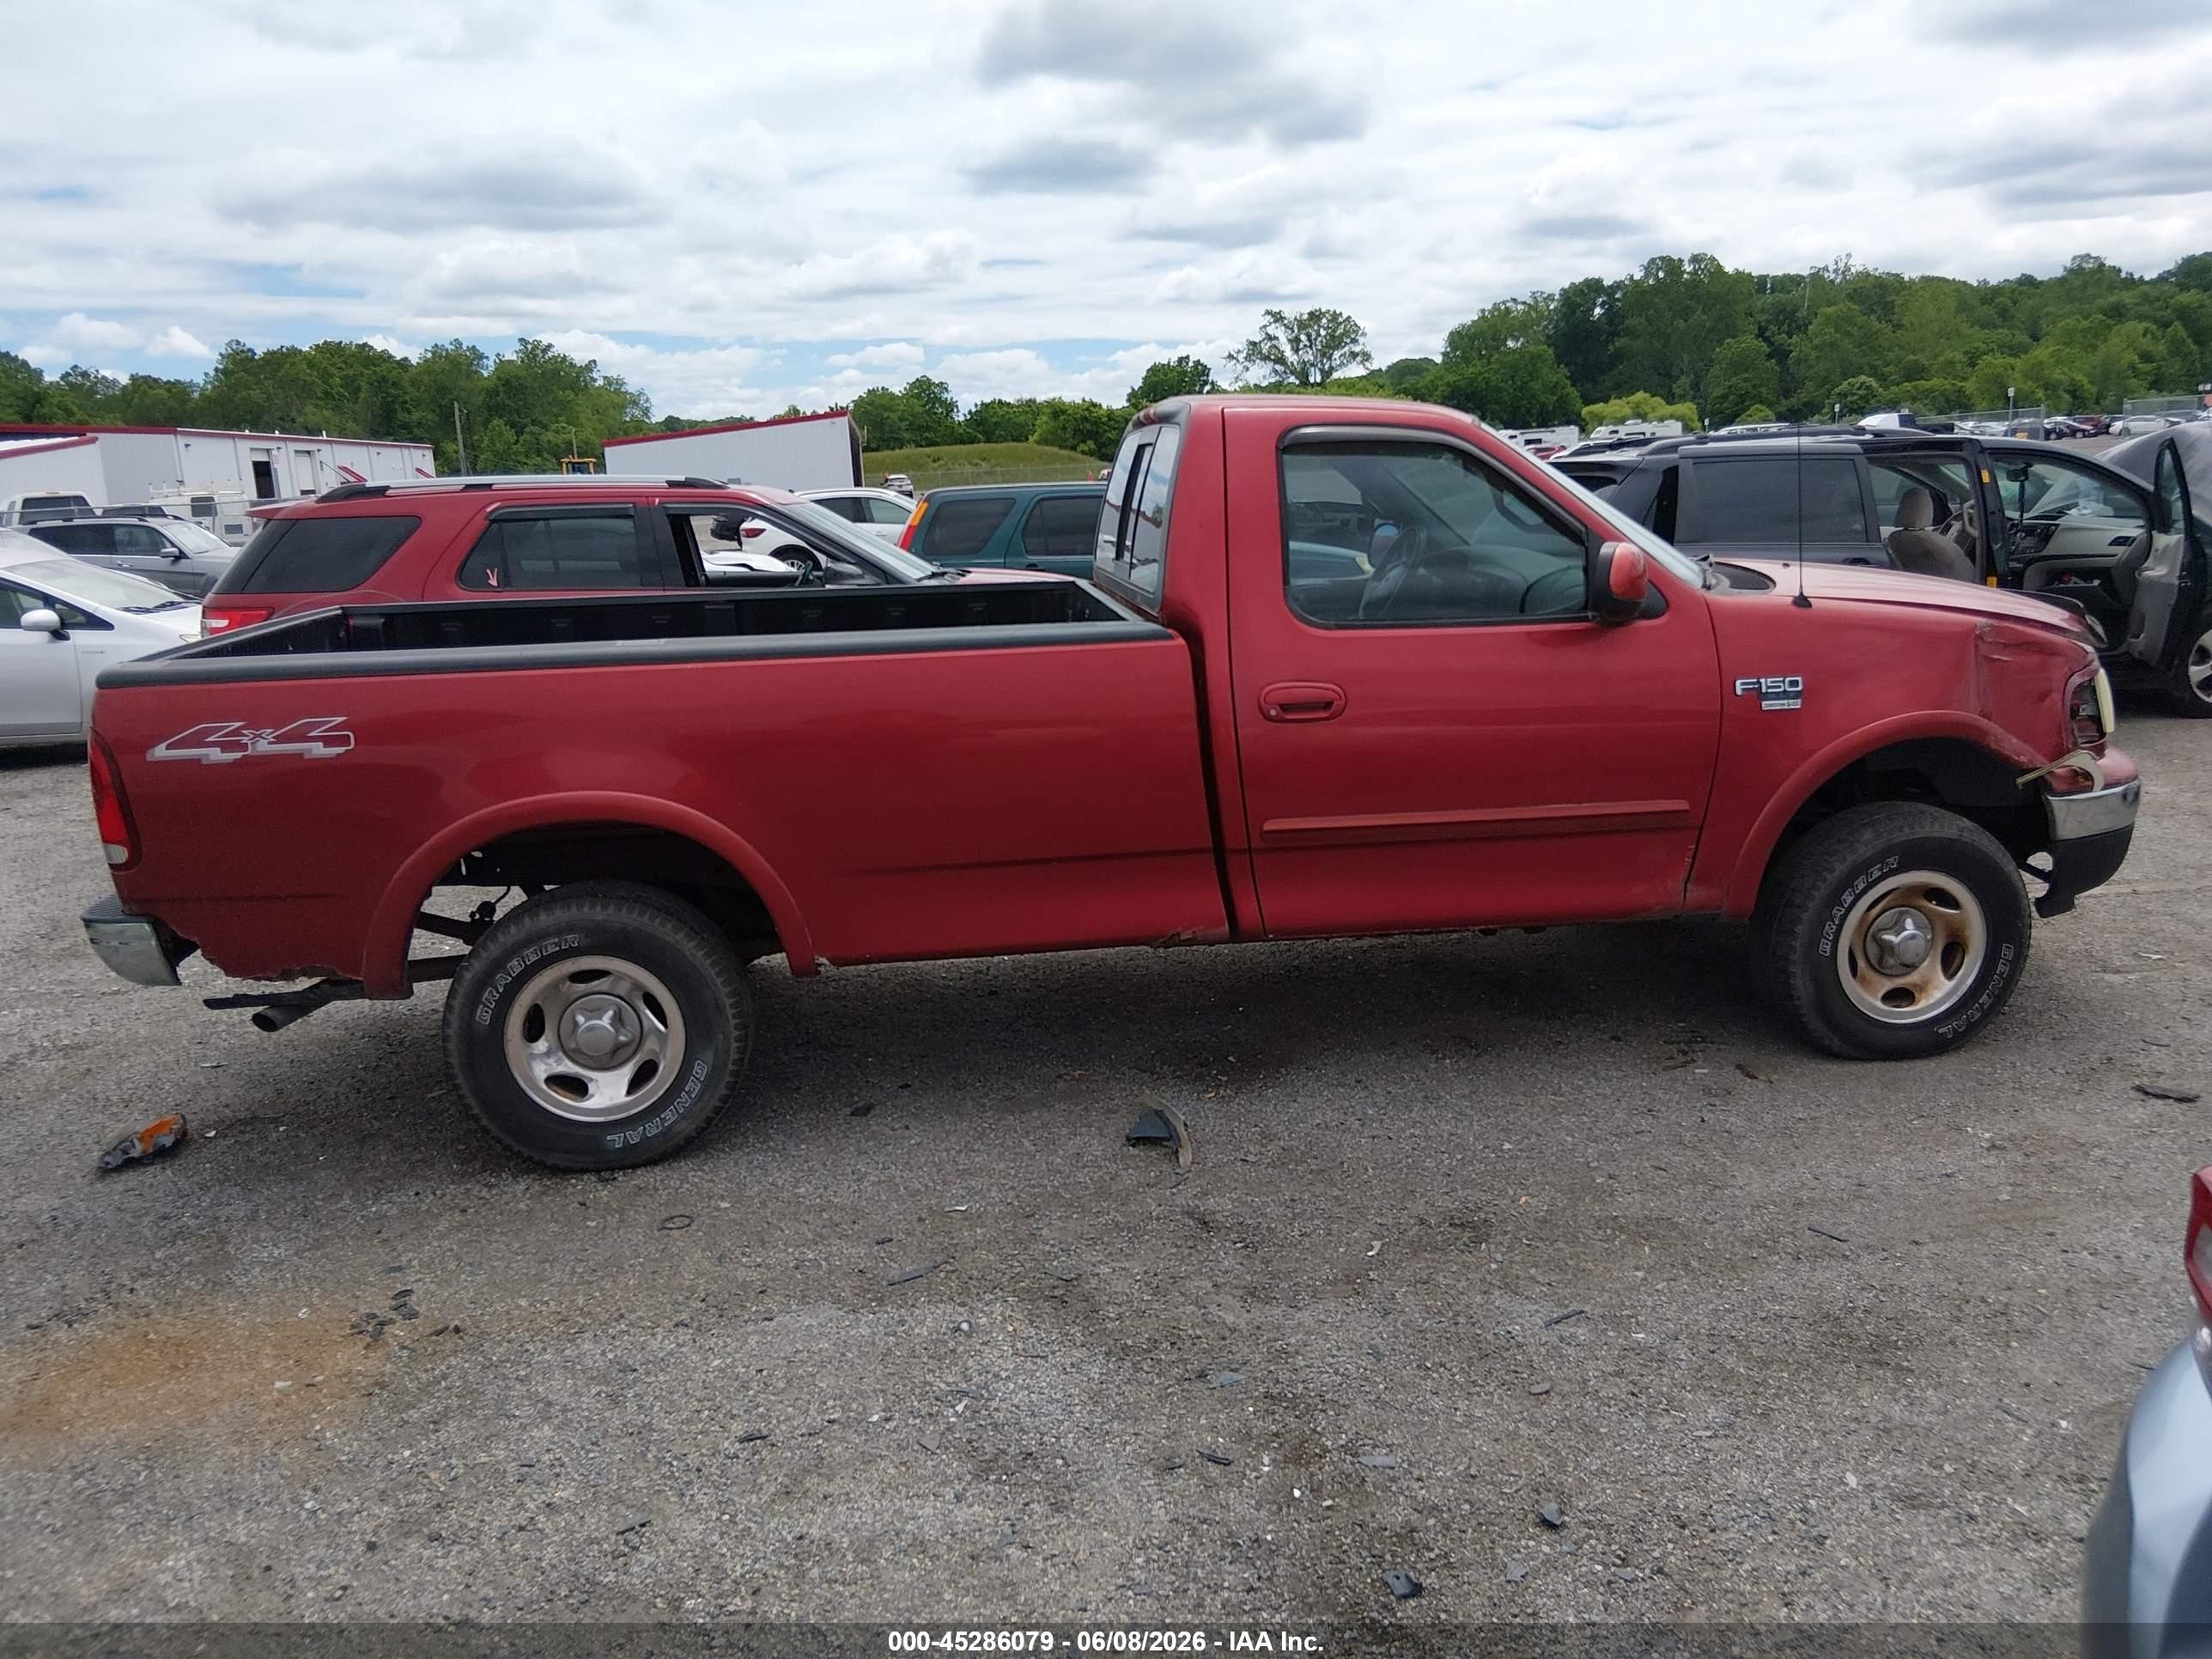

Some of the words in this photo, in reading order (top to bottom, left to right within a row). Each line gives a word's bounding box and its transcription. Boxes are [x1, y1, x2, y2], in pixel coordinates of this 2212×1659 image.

[1819, 855, 1899, 957] GRABBER
[475, 933, 582, 1026] GRABBER
[1934, 943, 2014, 1039] GENERAL
[606, 1060, 709, 1149] GENERAL
